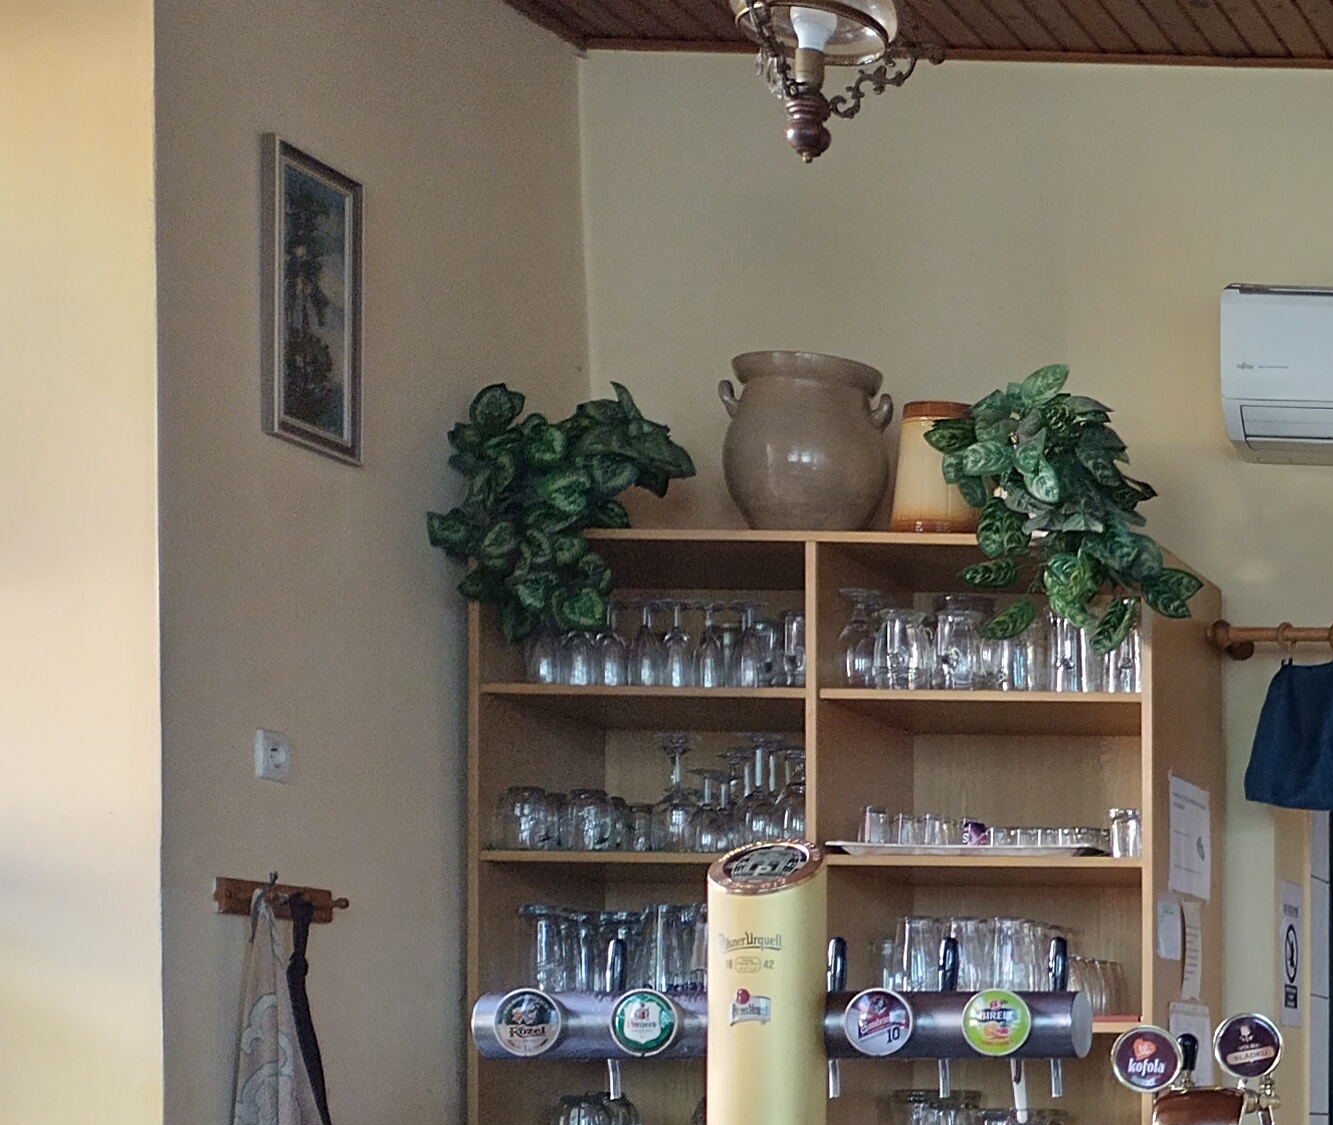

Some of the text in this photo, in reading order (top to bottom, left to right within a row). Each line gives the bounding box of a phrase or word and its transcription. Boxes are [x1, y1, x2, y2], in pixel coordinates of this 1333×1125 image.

[744, 931, 782, 951] Urquell
[763, 959, 775, 970] 42
[508, 1025, 546, 1038] Kozel
[886, 1026, 900, 1043] 10
[1127, 1058, 1165, 1077] kofola
